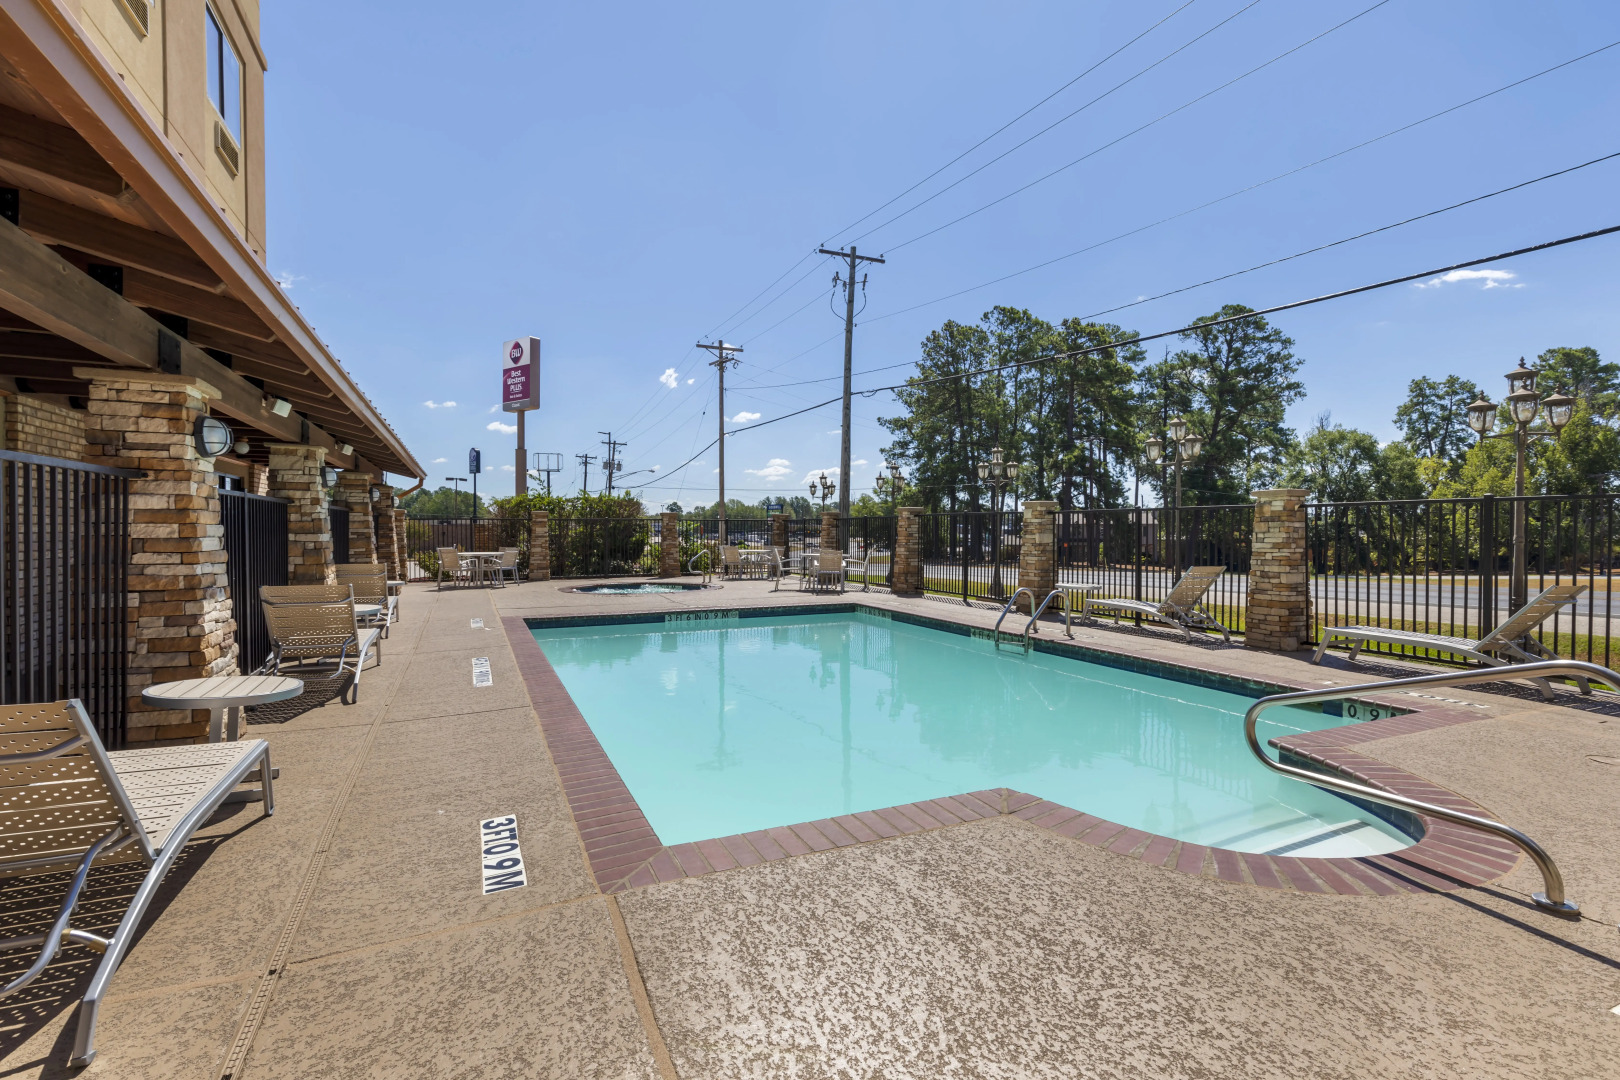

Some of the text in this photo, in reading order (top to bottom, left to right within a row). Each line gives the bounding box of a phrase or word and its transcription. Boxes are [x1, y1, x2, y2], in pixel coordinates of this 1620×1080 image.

[511, 348, 521, 358] BW
[507, 376, 525, 385] Western
[686, 613, 691, 621] 6
